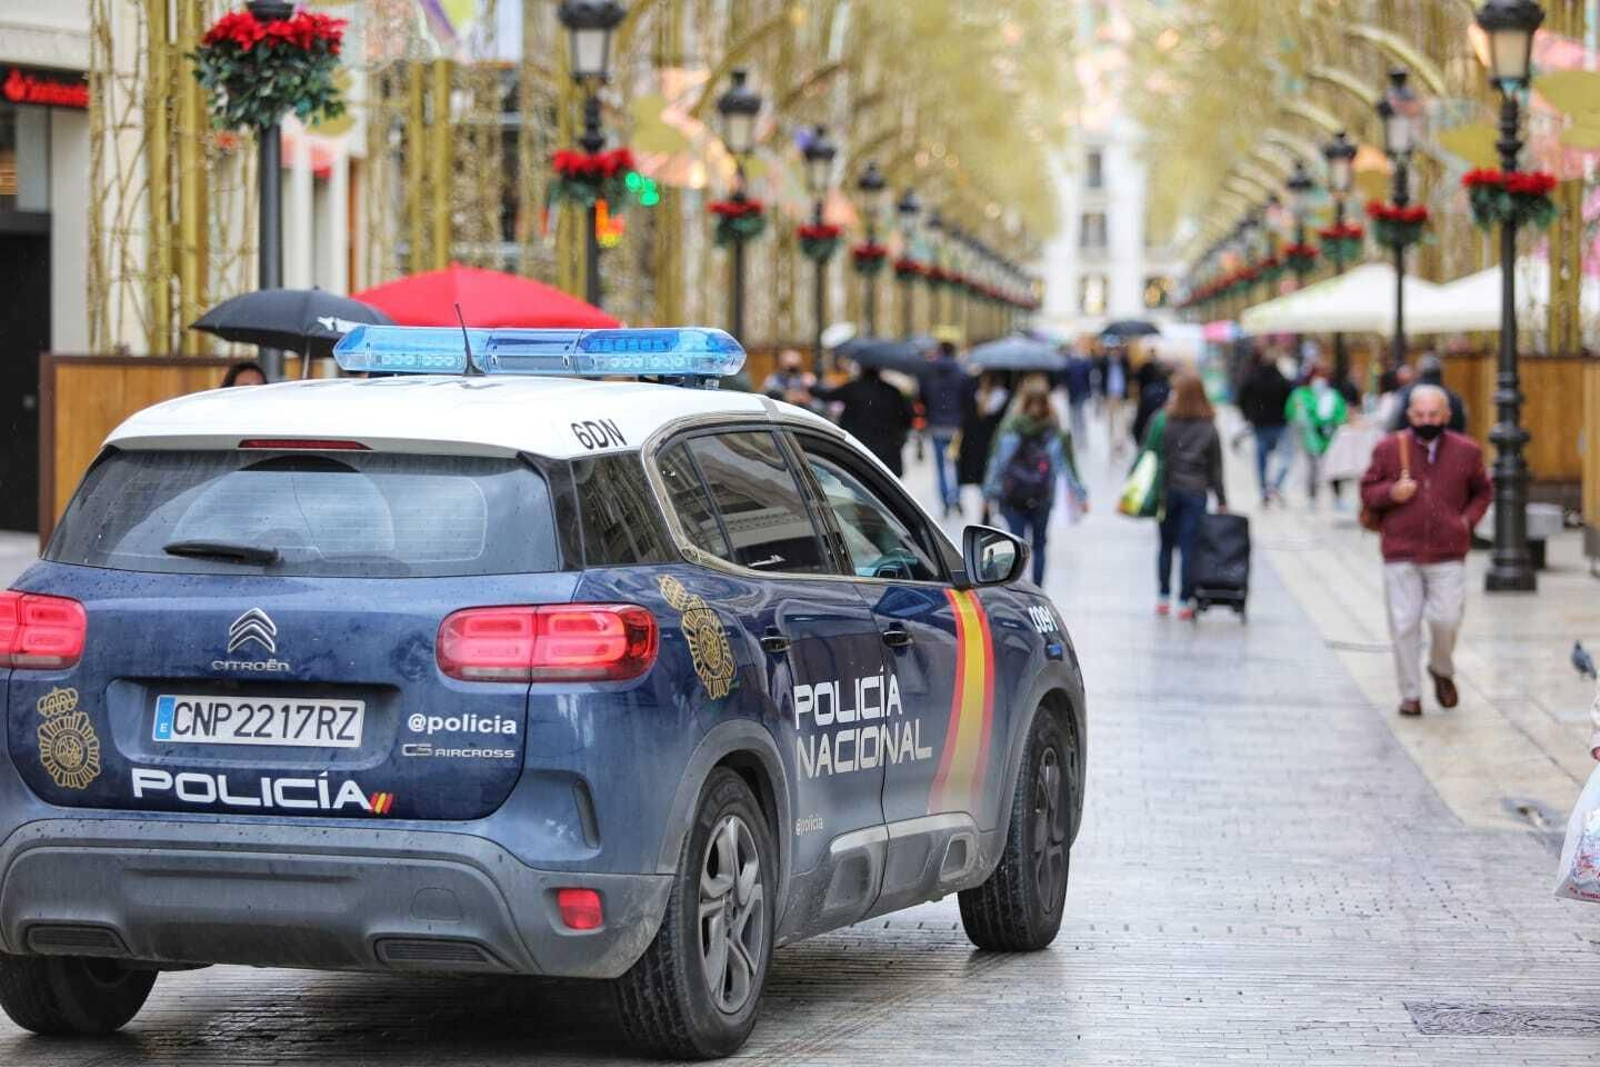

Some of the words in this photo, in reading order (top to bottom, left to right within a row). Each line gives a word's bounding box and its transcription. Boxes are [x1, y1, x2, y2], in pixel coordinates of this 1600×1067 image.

[571, 418, 628, 451] 6DN
[793, 664, 903, 730] POLICÍA
[172, 701, 359, 741] CNP2217RZ
[407, 712, 518, 735] @policia
[434, 747, 517, 758] AIRCROSS
[796, 718, 933, 781] NACIONAL
[131, 767, 374, 810] POLICÍA
